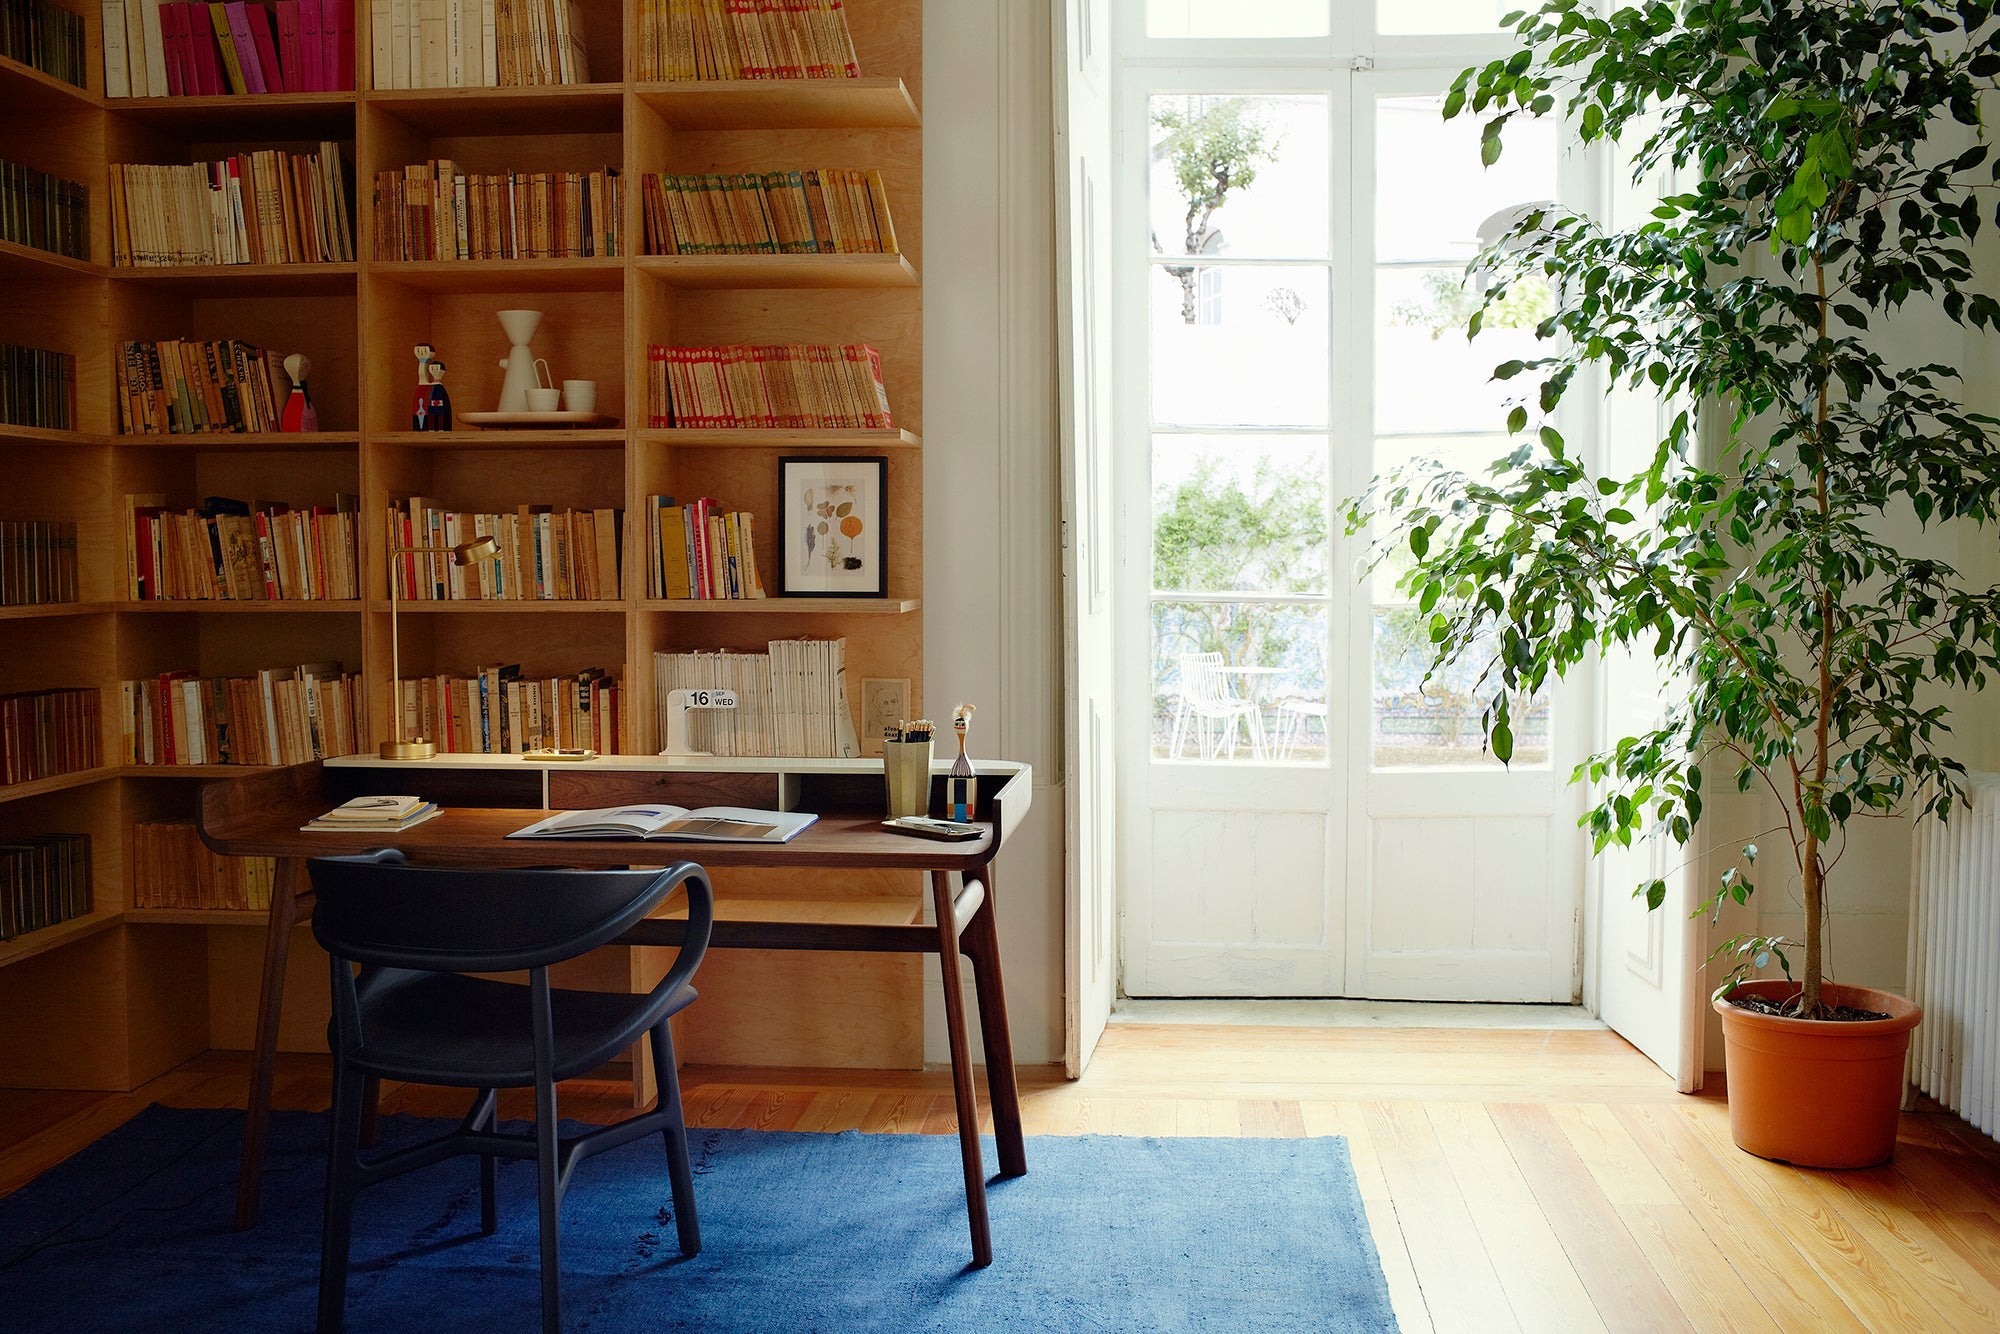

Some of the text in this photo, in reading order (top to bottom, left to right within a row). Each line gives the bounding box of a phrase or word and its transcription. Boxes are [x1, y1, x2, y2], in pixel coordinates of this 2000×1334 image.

[135, 352, 146, 394] GALLEGOS
[696, 548, 704, 581] LEONARD
[691, 691, 709, 706] 16
[714, 698, 734, 706] WED
